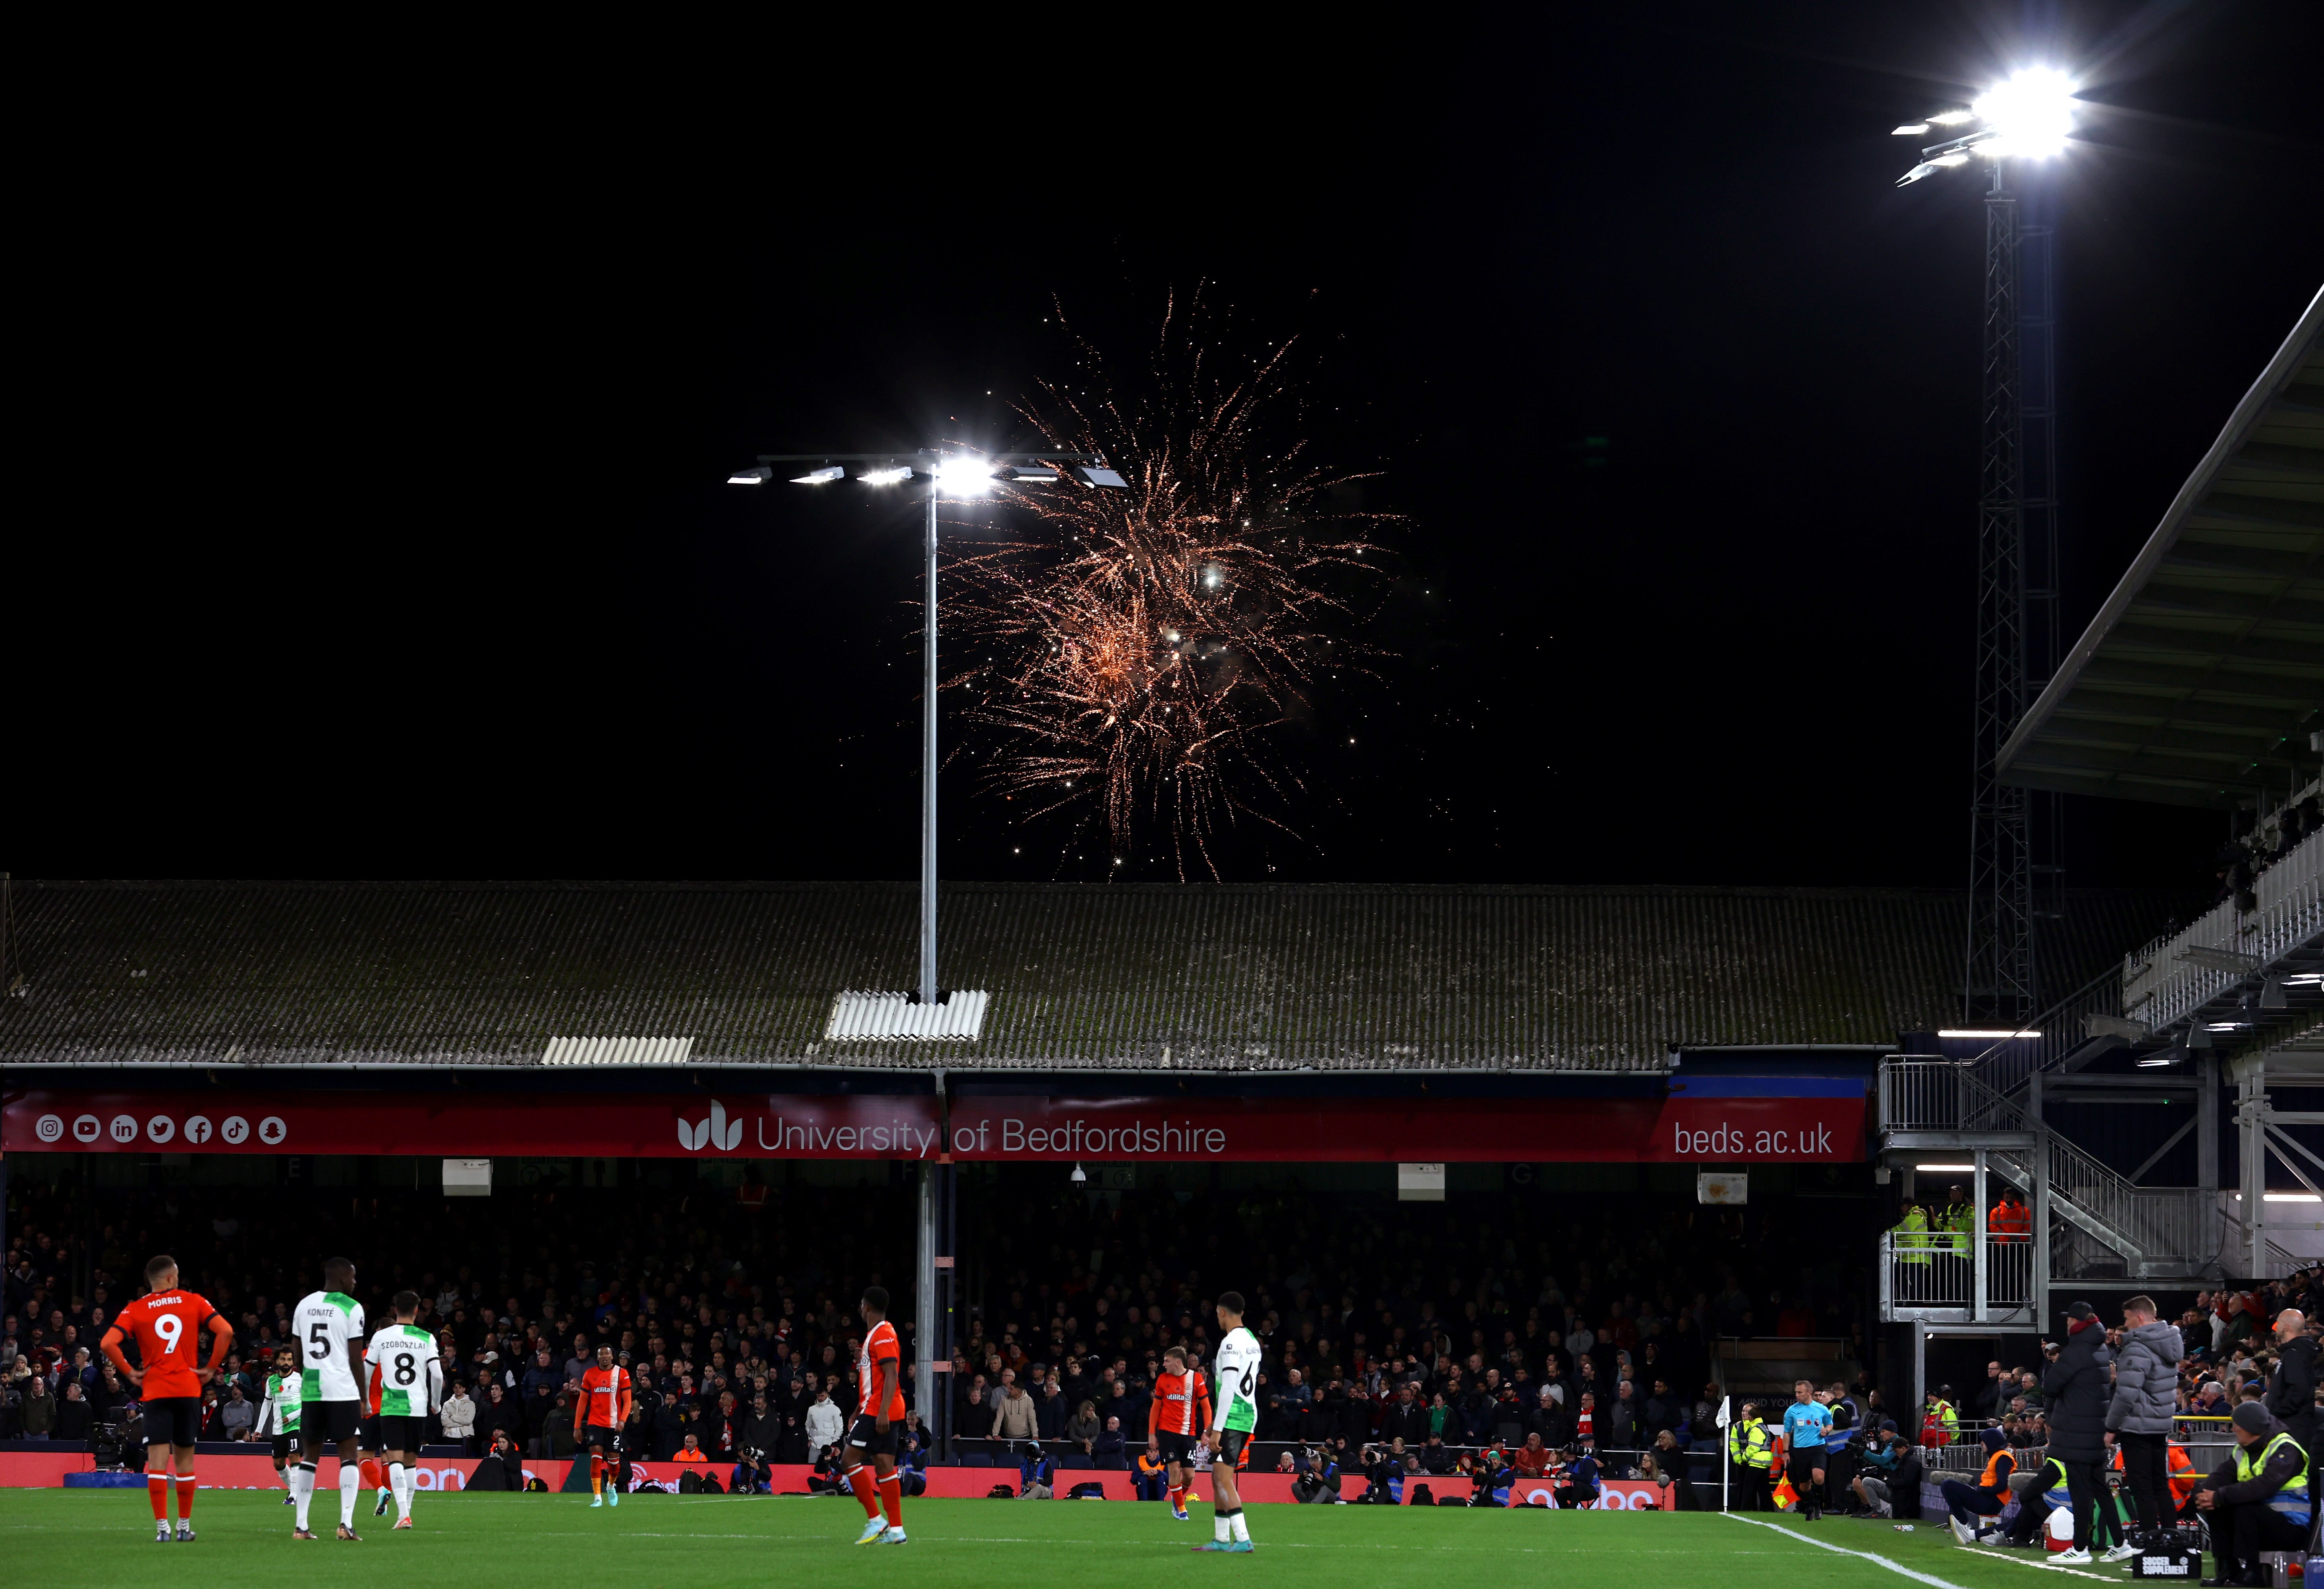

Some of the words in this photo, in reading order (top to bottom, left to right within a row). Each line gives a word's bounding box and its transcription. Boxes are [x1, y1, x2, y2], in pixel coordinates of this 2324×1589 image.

[758, 1117, 935, 1158] University
[954, 1120, 989, 1151] of
[1003, 1119, 1225, 1152] Bedfordshire
[1675, 1122, 1833, 1153] beds.ac.uk
[288, 1157, 301, 1178] E
[1512, 1163, 1532, 1184] G
[148, 1296, 182, 1309] MORRIS
[307, 1308, 334, 1317] KONATÉ
[155, 1313, 182, 1354] 9
[309, 1323, 330, 1359] 5
[381, 1341, 425, 1349] SZOBOSZLAI
[394, 1353, 416, 1386] 8
[290, 1438, 297, 1449] 11
[613, 1435, 620, 1445] 2
[2142, 1556, 2169, 1566] SOCCER
[2142, 1565, 2189, 1575] SUPPLEMENT
